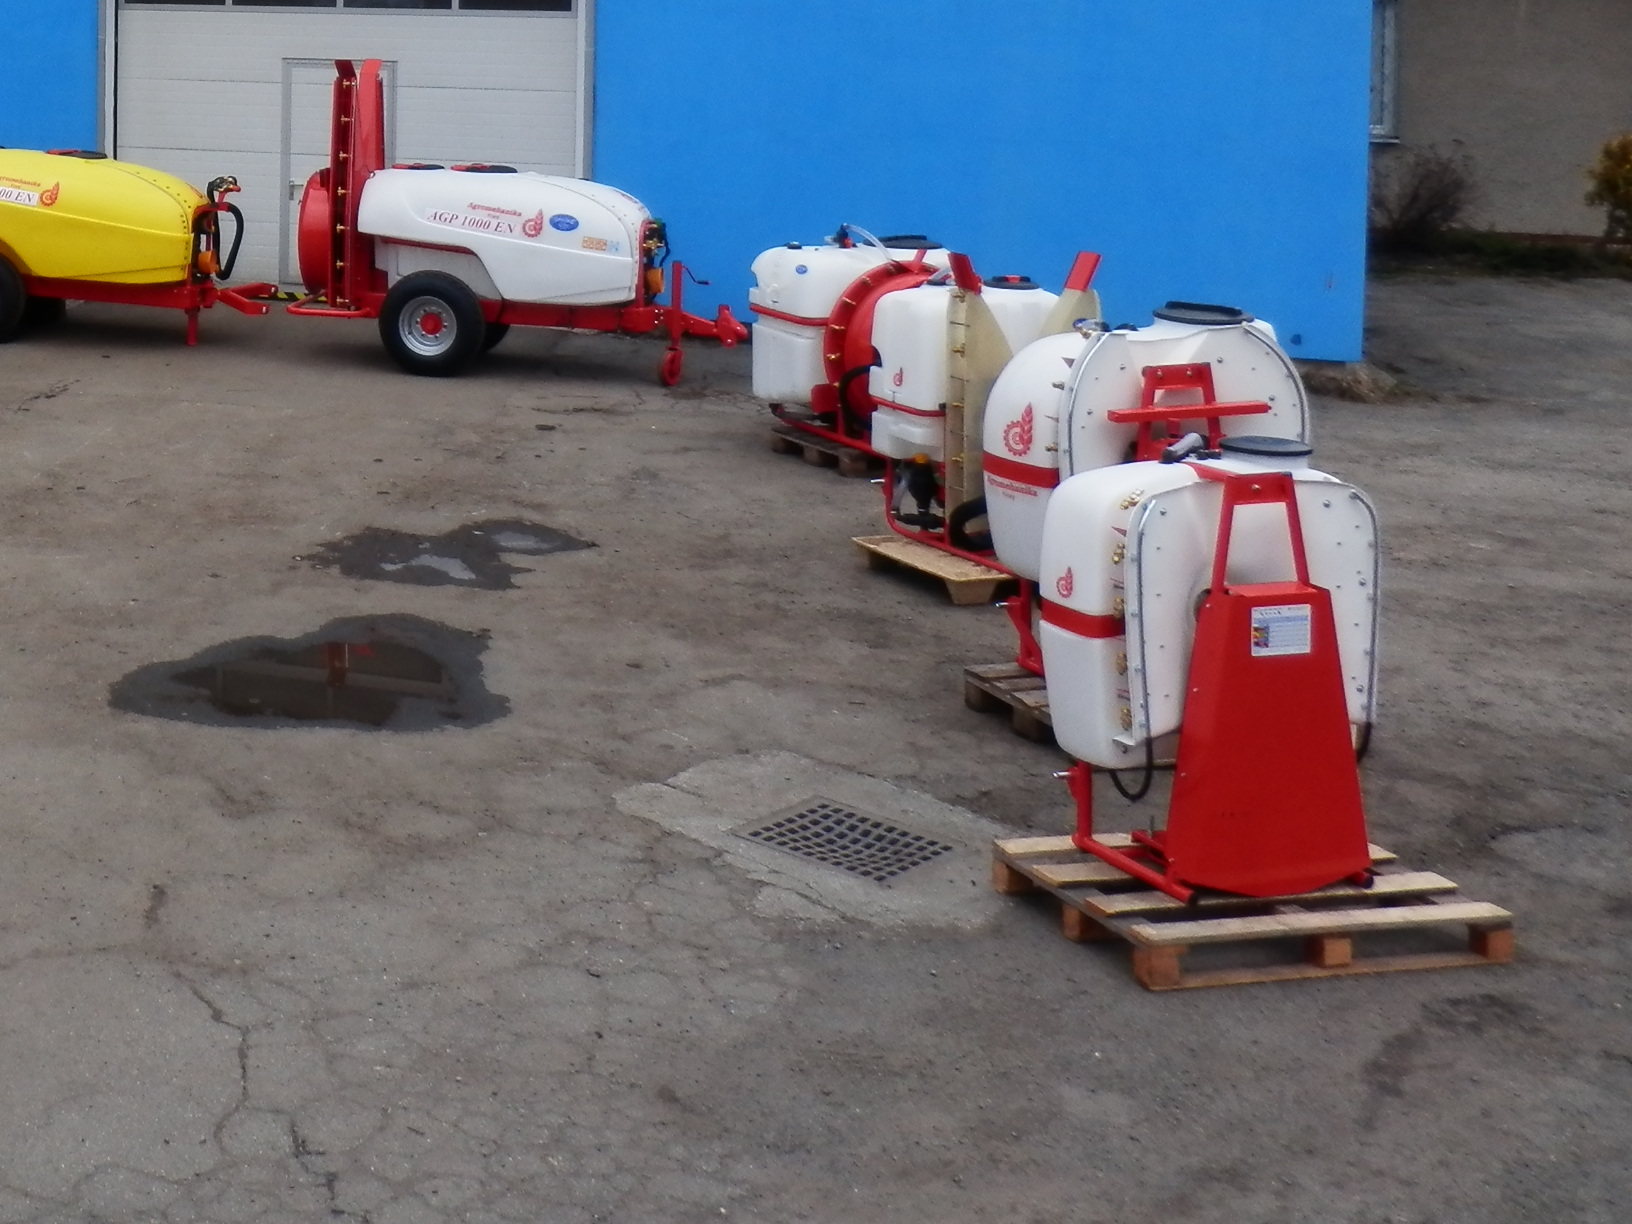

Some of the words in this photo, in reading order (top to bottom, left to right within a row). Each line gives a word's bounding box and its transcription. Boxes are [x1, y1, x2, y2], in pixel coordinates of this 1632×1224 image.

[15, 192, 35, 203] EN
[427, 211, 459, 224] AGP
[462, 216, 491, 230] 1000
[494, 222, 516, 234] EN
